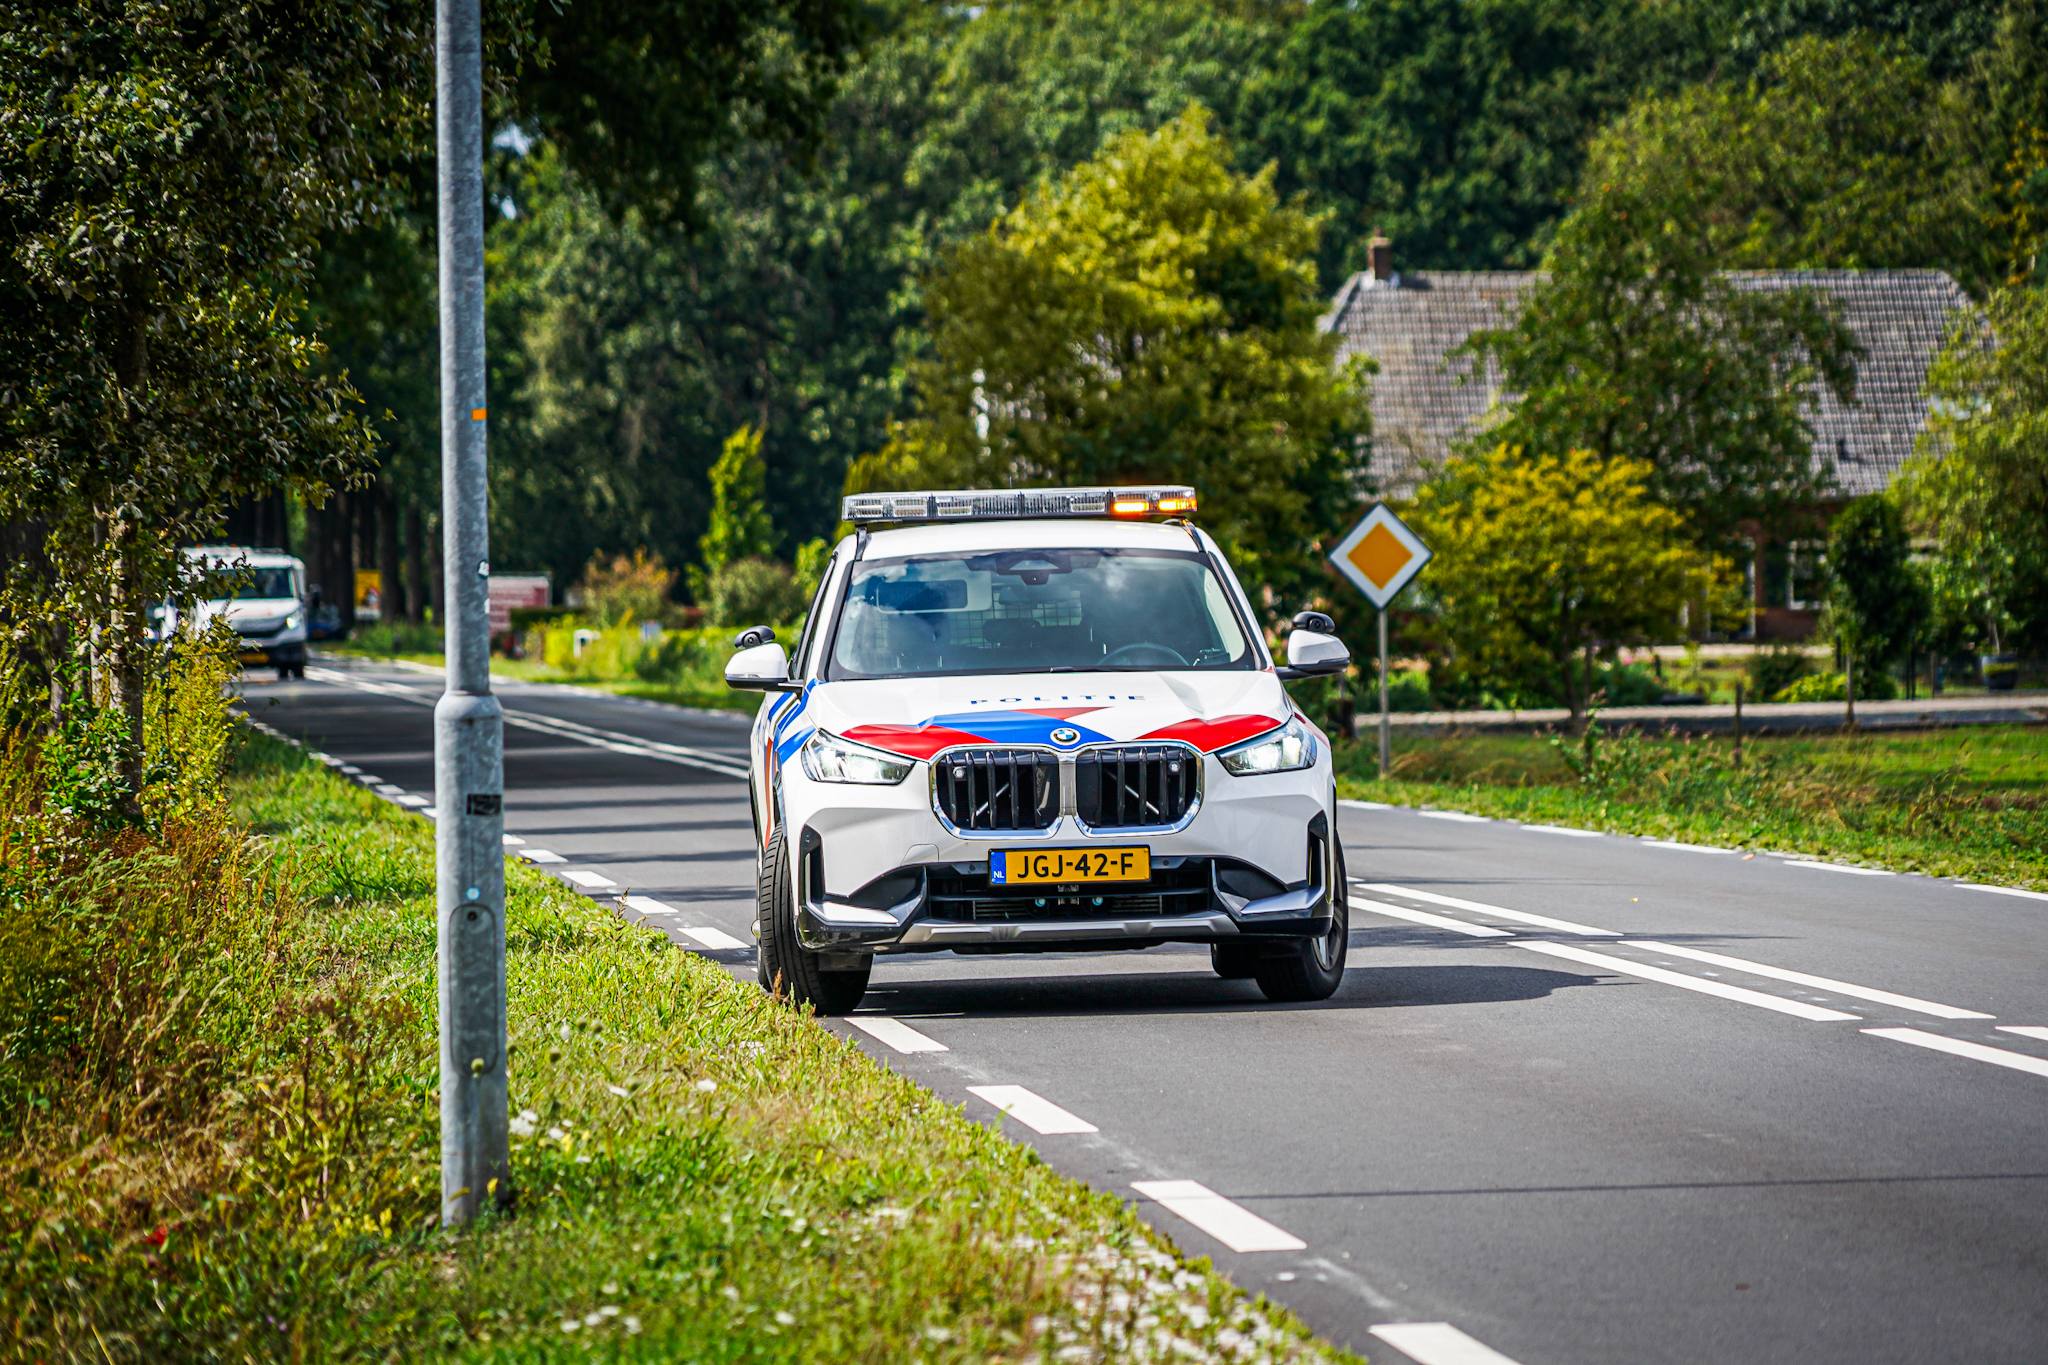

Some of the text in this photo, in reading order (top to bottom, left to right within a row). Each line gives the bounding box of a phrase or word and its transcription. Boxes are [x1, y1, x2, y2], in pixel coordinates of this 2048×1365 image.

[970, 695, 1145, 704] POLITIE
[1017, 853, 1133, 878] JGJ-42-F
[993, 870, 1005, 879] NL
